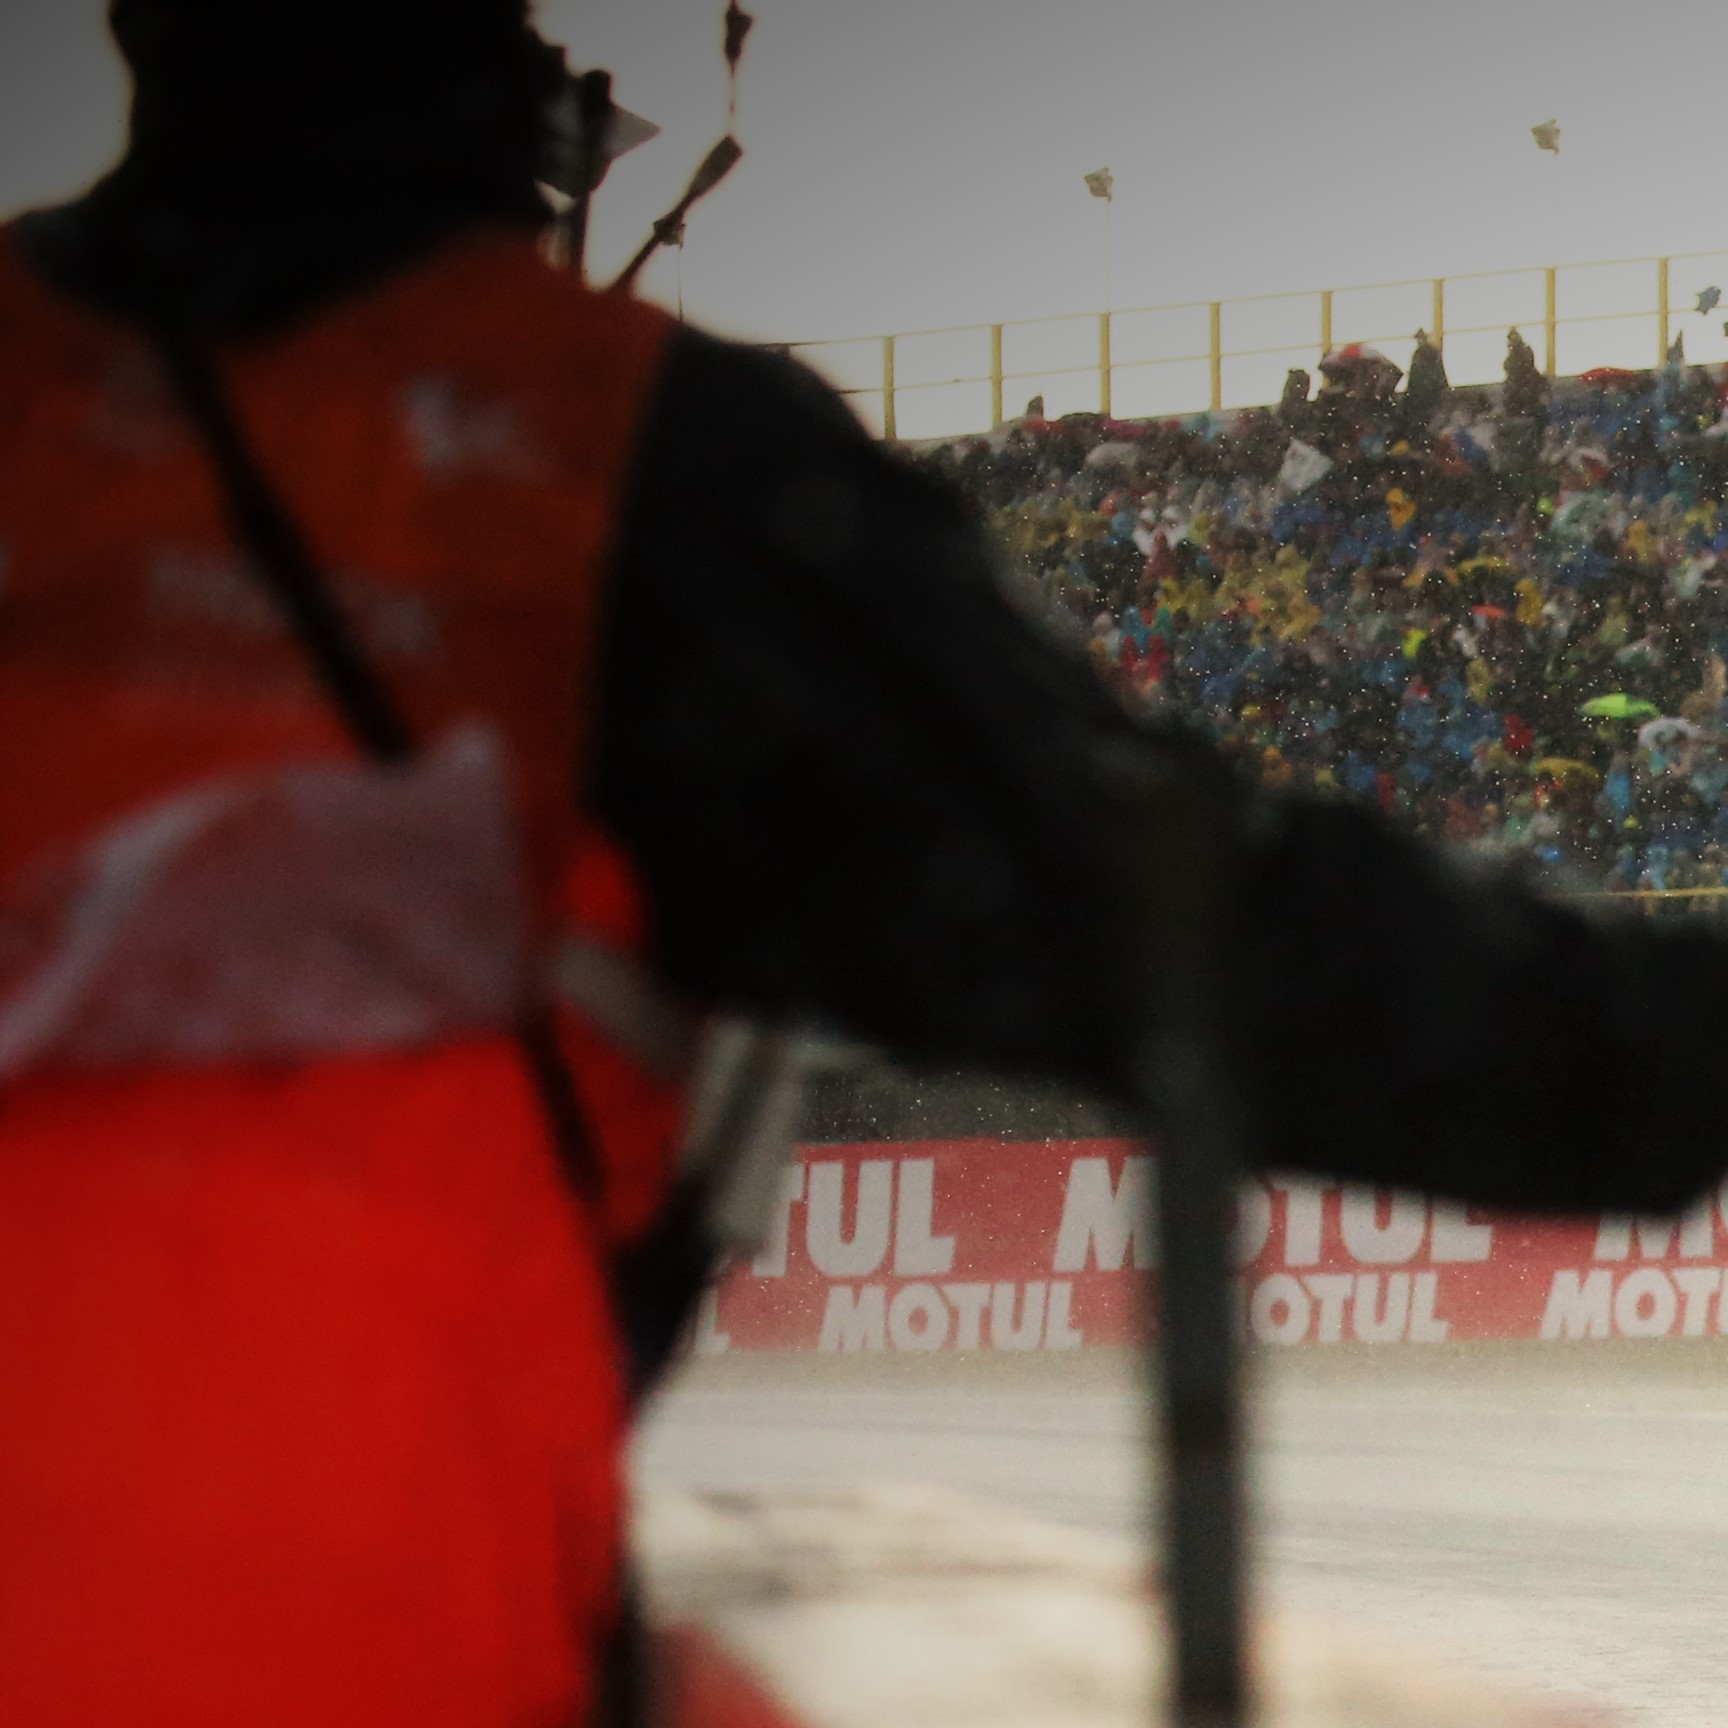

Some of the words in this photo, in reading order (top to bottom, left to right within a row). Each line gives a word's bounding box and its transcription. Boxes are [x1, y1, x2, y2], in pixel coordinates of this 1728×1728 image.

[750, 1157, 956, 1278] TUL
[818, 1281, 1083, 1353] MOTUL
[1236, 1272, 1450, 1346] OTUL
